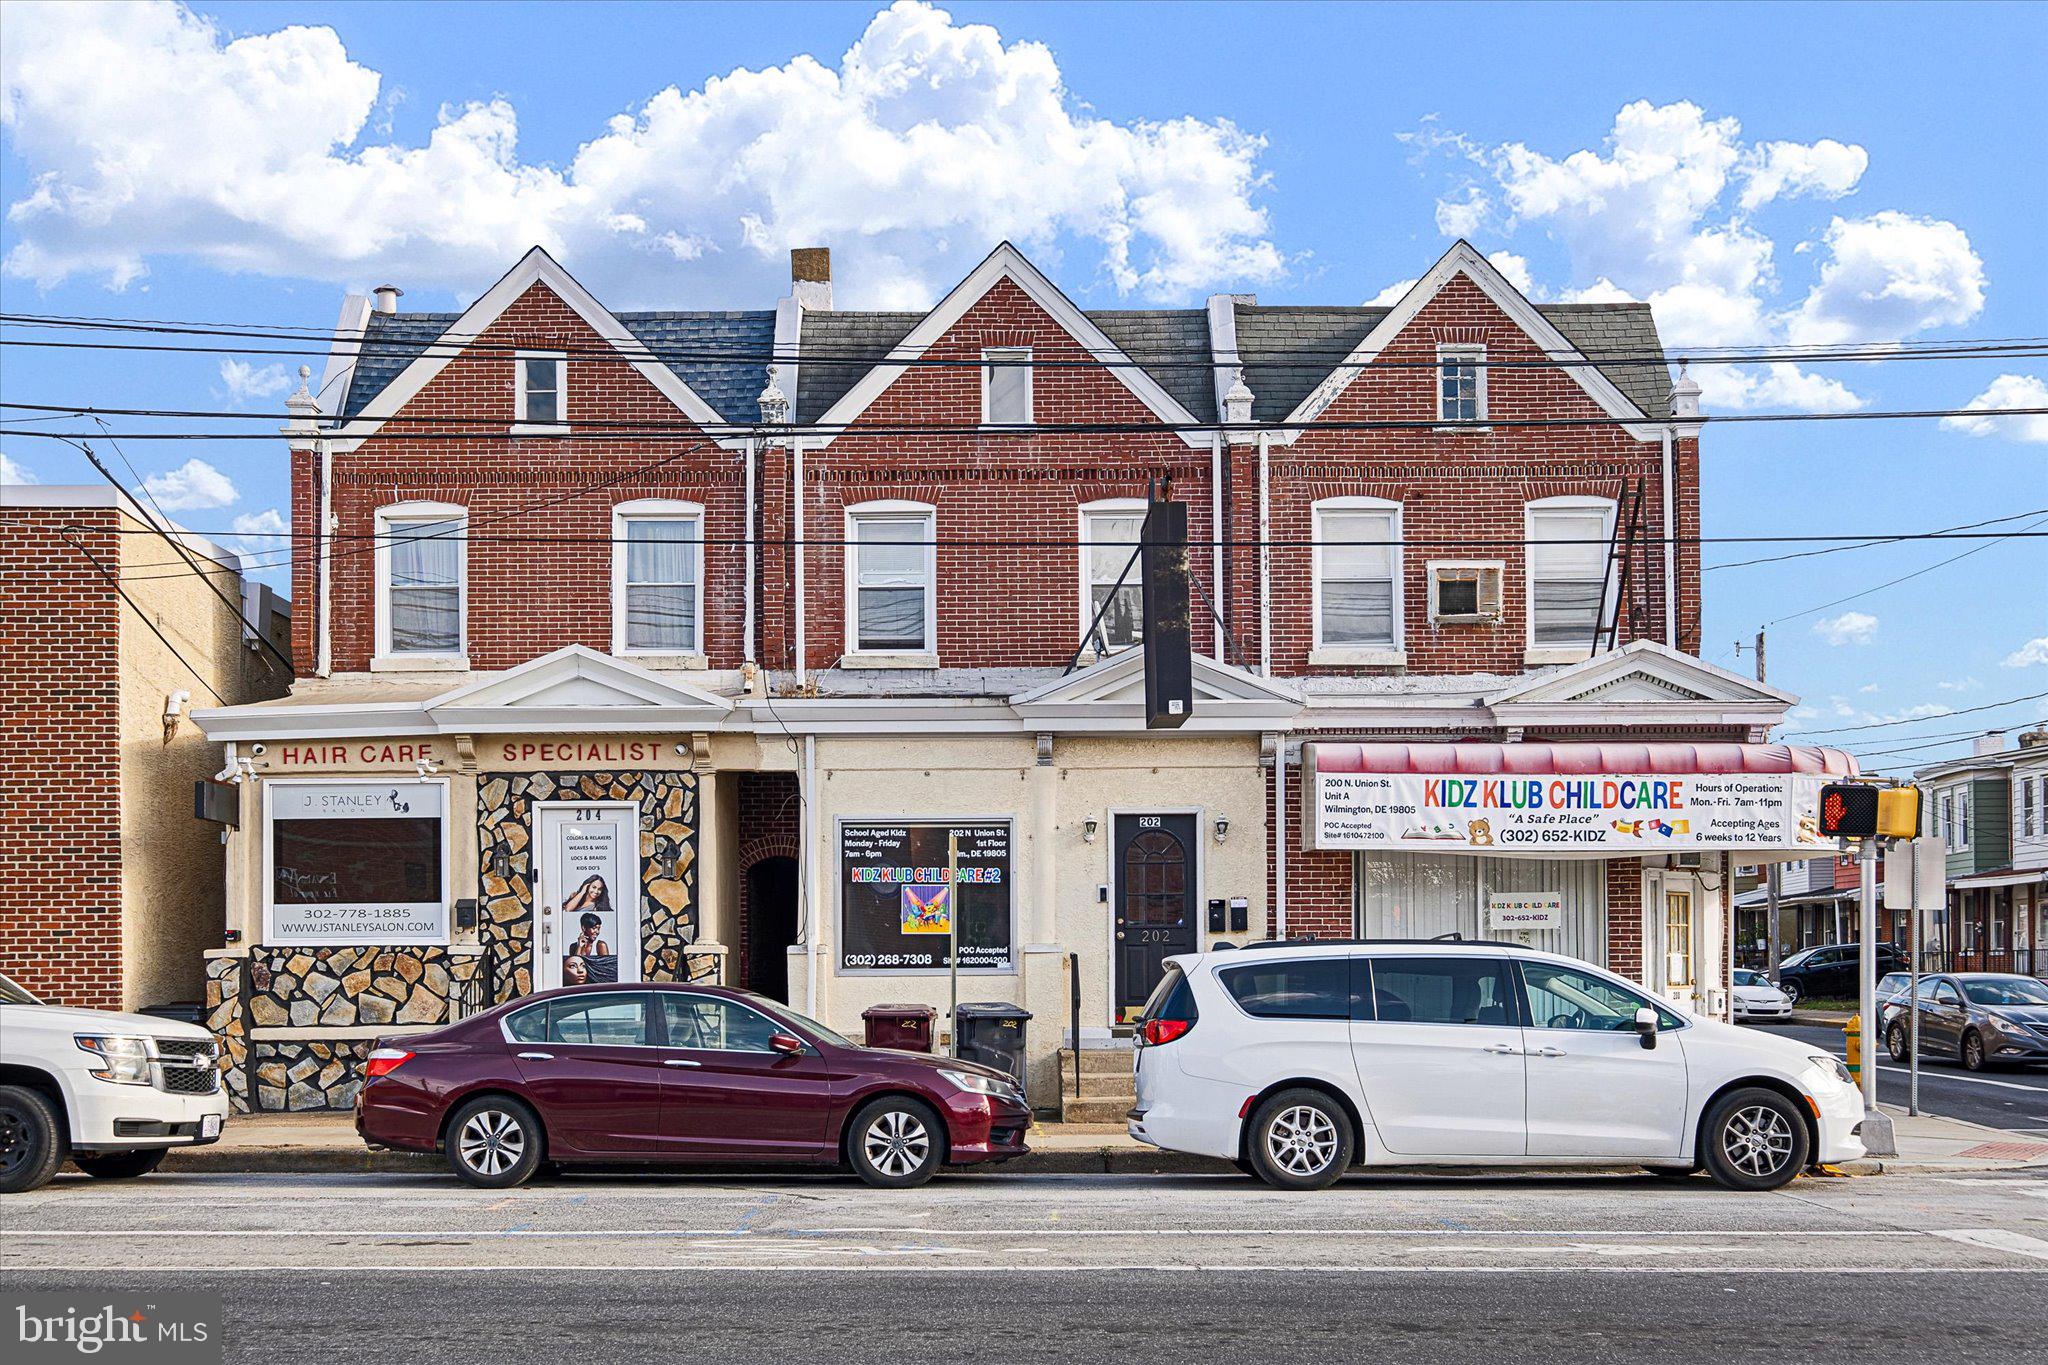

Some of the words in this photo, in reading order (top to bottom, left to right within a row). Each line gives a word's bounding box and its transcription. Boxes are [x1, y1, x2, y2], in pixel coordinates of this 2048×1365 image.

[283, 747, 347, 764] HAIR
[360, 744, 432, 764] CARE
[503, 743, 661, 762] SPECIALIST
[1325, 779, 1342, 787] 200
[1344, 779, 1353, 787] N.
[1355, 779, 1378, 787] Union
[1380, 780, 1391, 788] St.
[1696, 784, 1722, 792] Hours
[1724, 784, 1733, 792] of
[1735, 784, 1783, 794] Operation:
[1325, 792, 1341, 800] Unit
[1343, 792, 1350, 800] A
[1424, 779, 1478, 808] KIDZ
[1483, 779, 1543, 809] KLUB
[1550, 780, 1683, 810] CHILDCARE
[322, 795, 381, 806] STANLEY
[576, 809, 601, 820] 204
[1325, 805, 1373, 815] Wilmington,
[1375, 805, 1387, 813] DE
[1389, 806, 1416, 814] 19805
[1141, 817, 1159, 826] 202
[1527, 814, 1555, 824] Safe
[1341, 822, 1372, 830] Accepted
[1711, 819, 1755, 830] Accepting
[1757, 819, 1780, 830] Ages
[871, 829, 889, 838] Aged
[1500, 829, 1539, 843] (302)
[1542, 830, 1606, 842] 652-KIDZ
[1696, 833, 1702, 841] 6
[1705, 833, 1732, 841] weeks
[1745, 833, 1756, 841] 12
[1758, 833, 1781, 842] Years
[845, 840, 873, 848] Monday
[879, 840, 900, 848] Friday
[866, 850, 882, 858] 6pm
[852, 867, 880, 882] KIDZ
[882, 867, 913, 882] KLUB
[914, 867, 982, 883] CHILDARE
[984, 867, 1000, 882] #2
[304, 909, 411, 918] 302-778-1885
[282, 922, 434, 933] WWW.JSTANLEYSALON.COM
[1141, 930, 1170, 942] 202
[976, 947, 1008, 955] Accepted
[845, 954, 876, 966] (302)
[877, 954, 932, 965] 268-7308
[1002, 1019, 1017, 1029] 202
